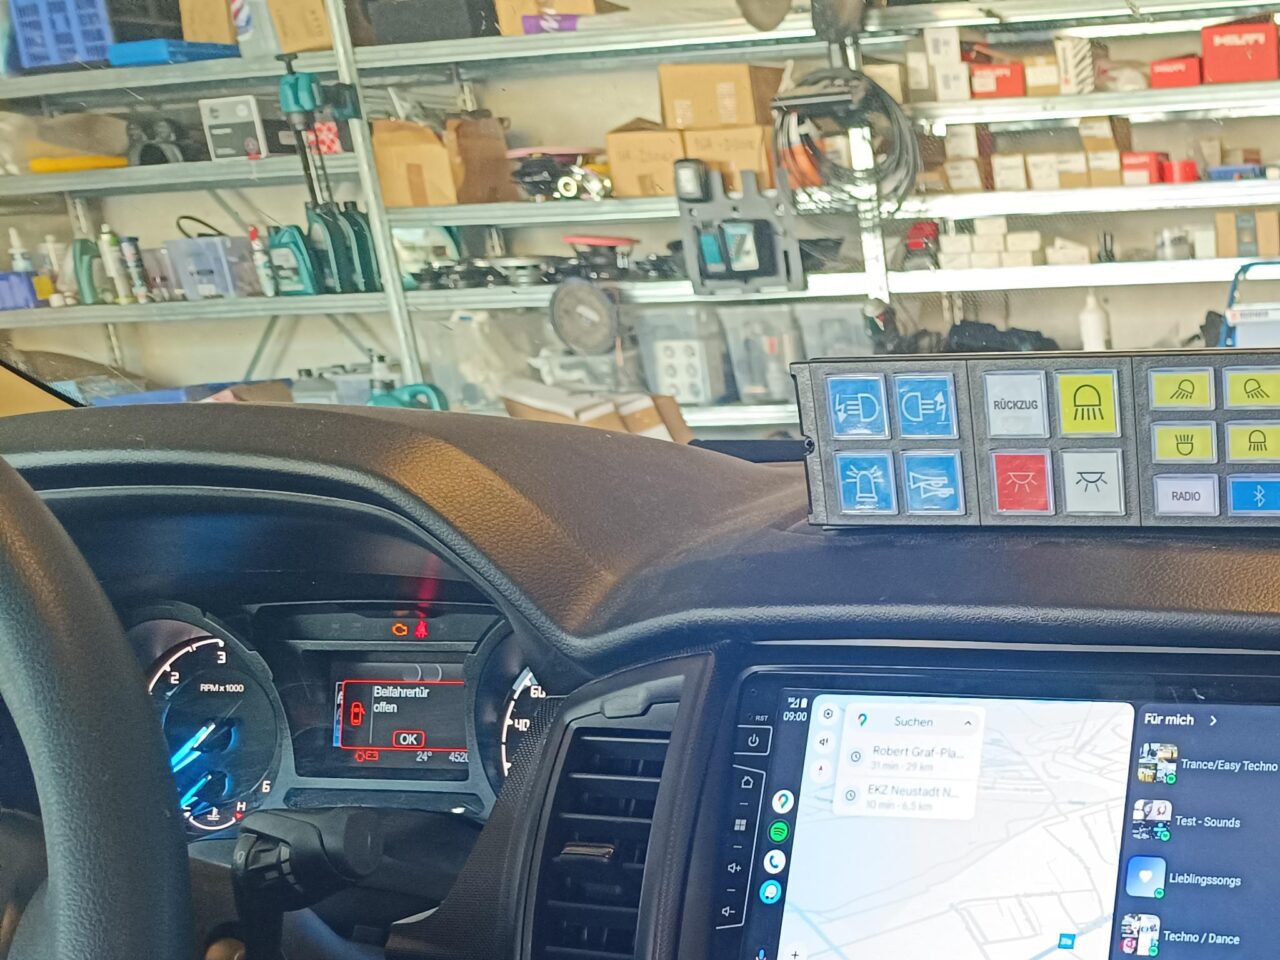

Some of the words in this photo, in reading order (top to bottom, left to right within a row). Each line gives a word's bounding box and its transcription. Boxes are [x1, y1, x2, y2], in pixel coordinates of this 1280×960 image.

[993, 398, 1038, 411] RÜCKZUG
[1171, 490, 1201, 502] RADIO
[217, 651, 226, 664] 3
[170, 671, 180, 684] 2
[200, 684, 219, 692] RPM
[225, 684, 244, 693] 1000
[374, 686, 429, 698] Beifahrertür
[374, 702, 397, 713] offen
[782, 711, 807, 722] 09:00
[894, 717, 933, 727] Suchen
[1144, 713, 1163, 725] Für
[1165, 714, 1194, 726] mich
[400, 733, 417, 745] OK
[416, 751, 433, 762] 24°
[873, 745, 909, 757] Robert
[882, 762, 899, 770] min
[920, 763, 934, 771] km
[1181, 759, 1241, 773] Trance/Easy
[1242, 760, 1278, 772] Techno
[262, 780, 271, 793] 6
[868, 784, 888, 795] EKZ
[891, 785, 940, 797] Neustadt
[237, 802, 246, 811] H
[878, 801, 895, 809] min
[918, 802, 933, 811] km
[1176, 816, 1197, 826] Test
[1204, 817, 1240, 828] Sounds
[1169, 873, 1242, 888] Lieblingssongs
[1163, 931, 1200, 943] Techno
[1208, 933, 1240, 945] Dance
